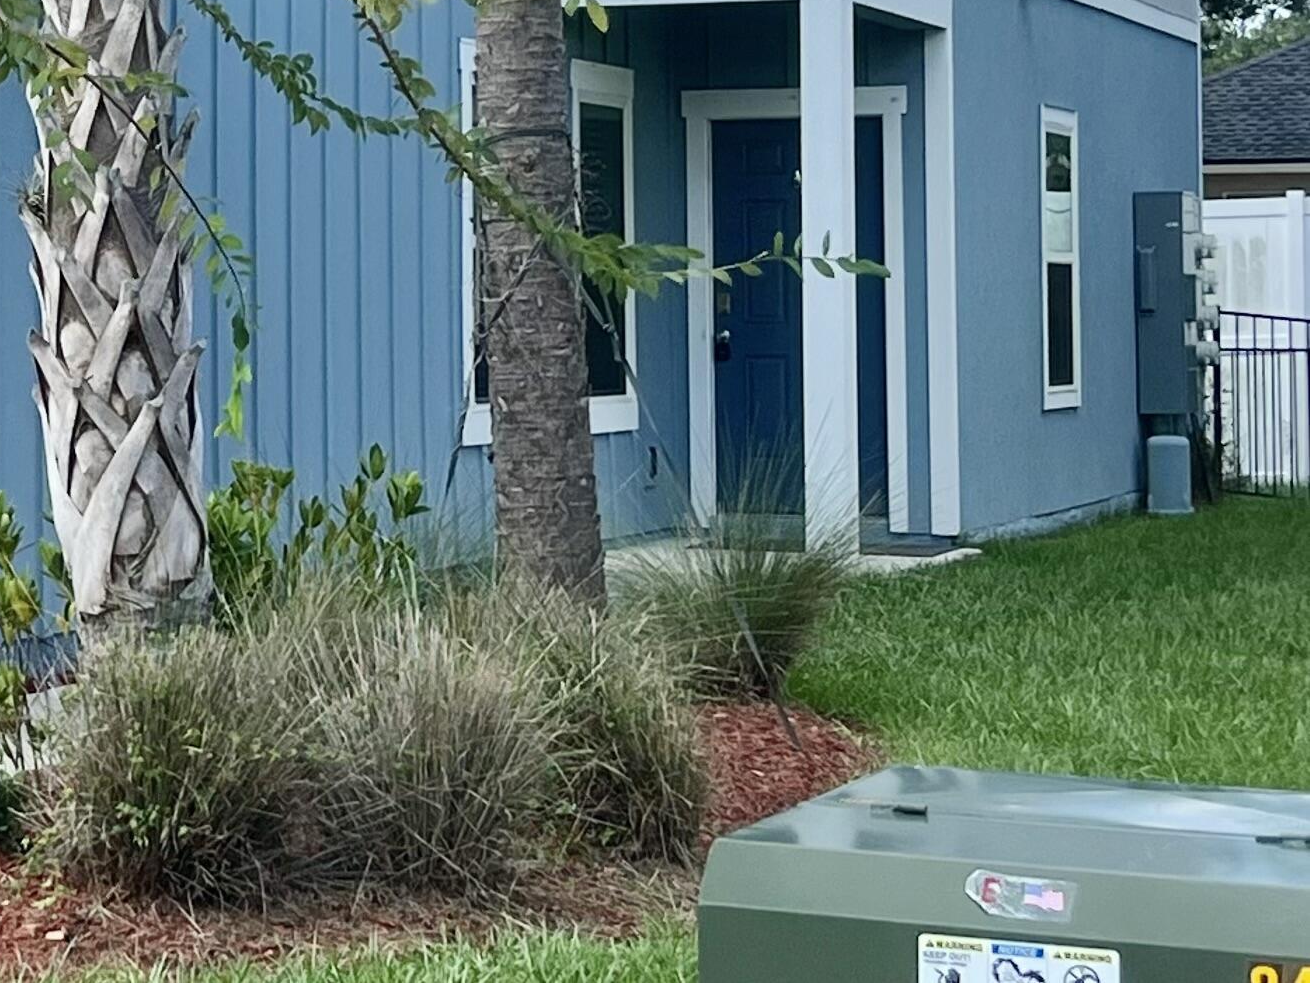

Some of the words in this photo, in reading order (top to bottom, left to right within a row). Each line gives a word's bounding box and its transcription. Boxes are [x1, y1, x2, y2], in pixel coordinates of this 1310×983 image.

[936, 940, 983, 951] WARNING
[998, 944, 1037, 957] NOTICE
[922, 950, 947, 959] KEEP
[1063, 951, 1112, 963] WARNING
